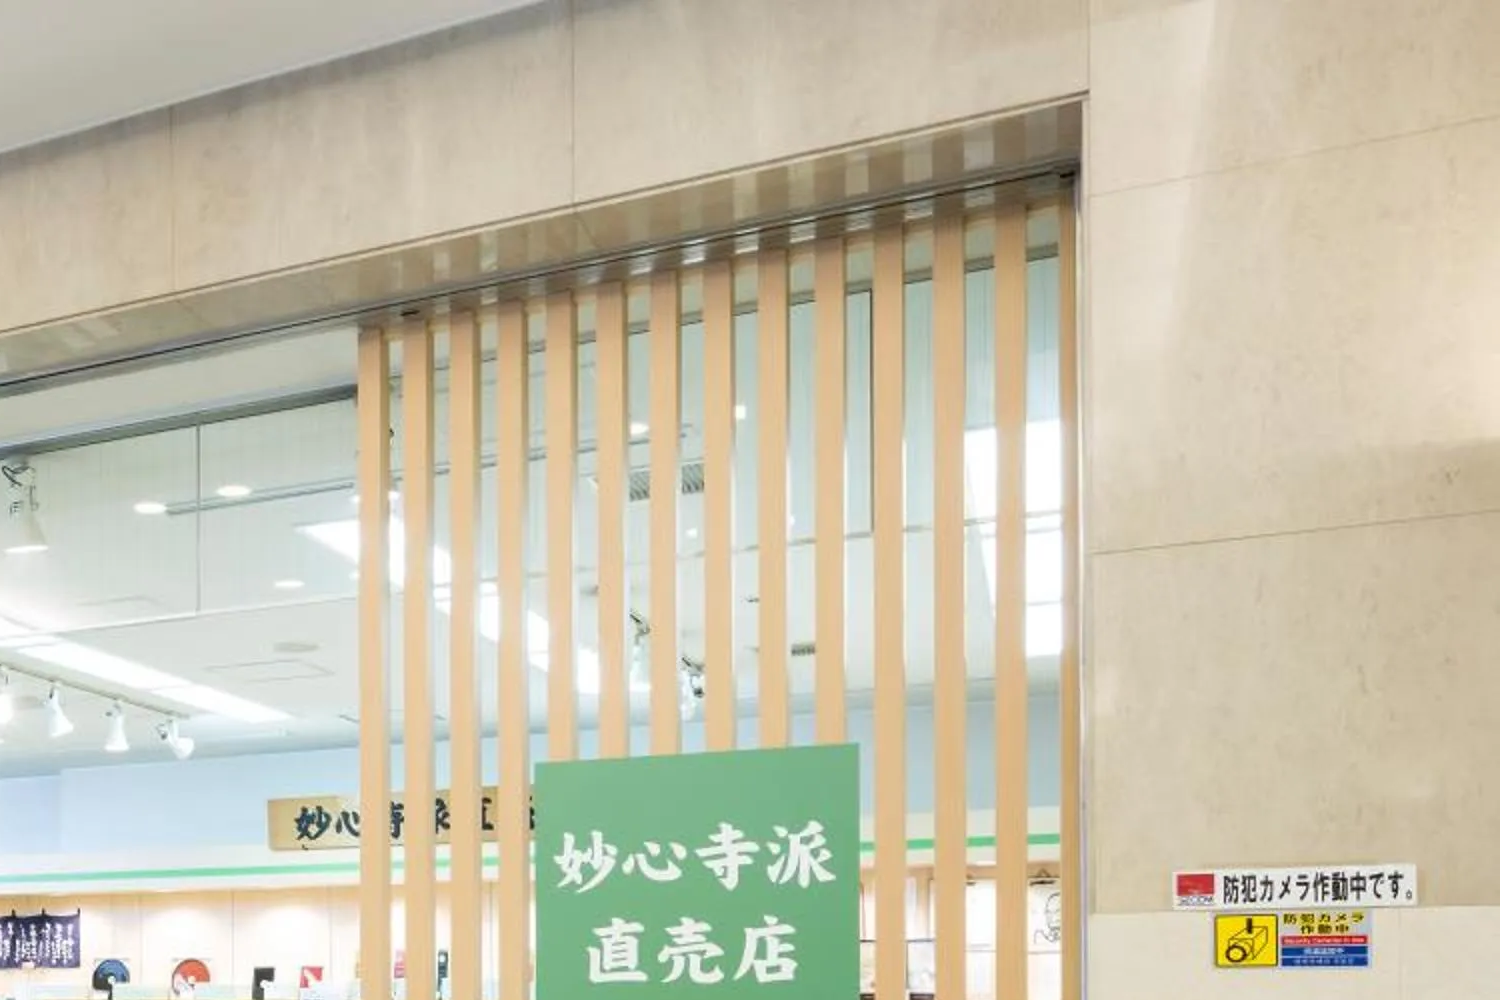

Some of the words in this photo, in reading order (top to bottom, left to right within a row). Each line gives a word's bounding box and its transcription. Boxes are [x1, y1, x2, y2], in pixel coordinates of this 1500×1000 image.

[554, 820, 836, 893] 妙心寺派
[1223, 871, 1412, 904] 防犯カメラ作動中です。
[1283, 912, 1364, 924] 防犯カメラ
[586, 916, 798, 985] 直売店
